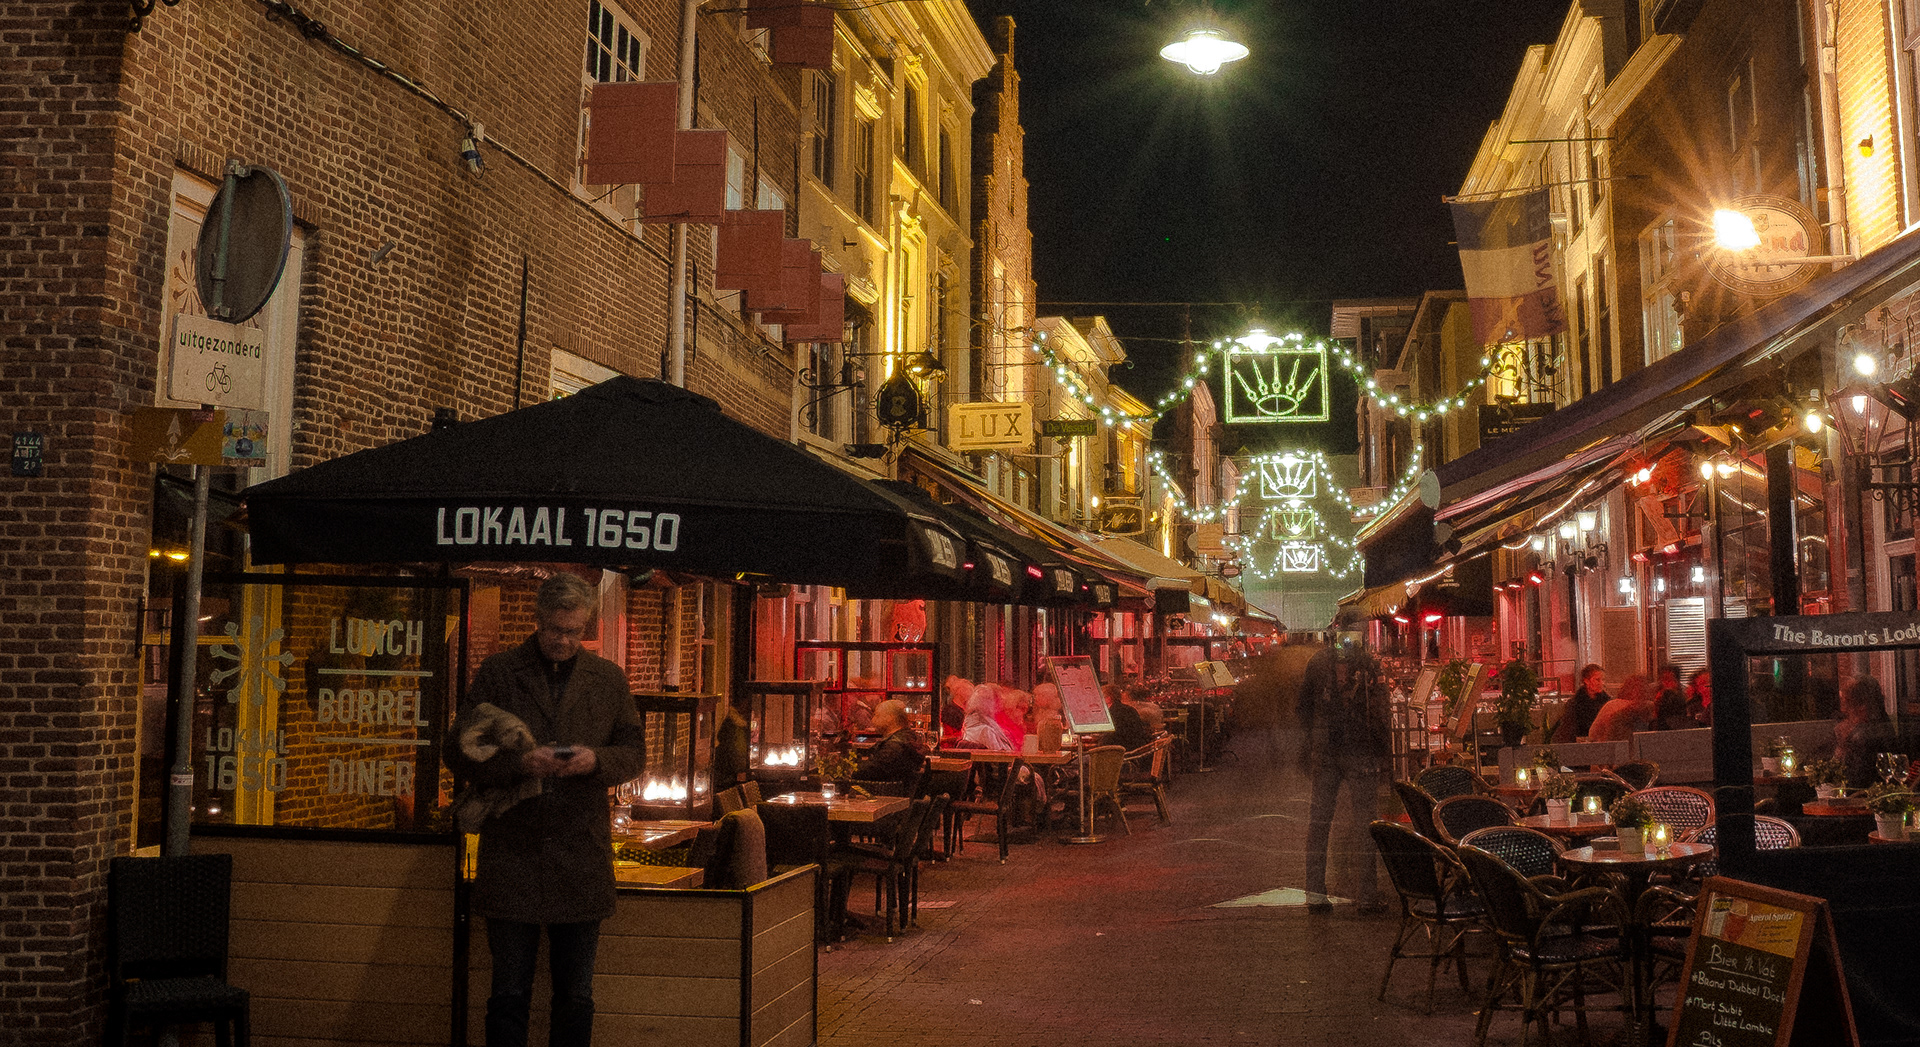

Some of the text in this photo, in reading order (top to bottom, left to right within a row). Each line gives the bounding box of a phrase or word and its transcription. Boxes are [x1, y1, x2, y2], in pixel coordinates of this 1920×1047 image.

[180, 330, 261, 359] uitgezonderd
[959, 413, 1022, 438] LUX
[437, 506, 680, 551] LOKAAL 1650
[329, 618, 423, 656] LUNCH
[1773, 624, 1806, 644] The
[1811, 629, 1879, 647] Baron's
[317, 688, 429, 727] BORREL
[206, 727, 290, 755] LOKAAL
[204, 756, 287, 792] 1650
[328, 758, 413, 796] DINER
[1728, 979, 1761, 997] Dubbel
[1717, 1002, 1743, 1016] Subit
[1713, 1012, 1773, 1035] Witte Lambic
[1700, 1030, 1722, 1047] Pils
